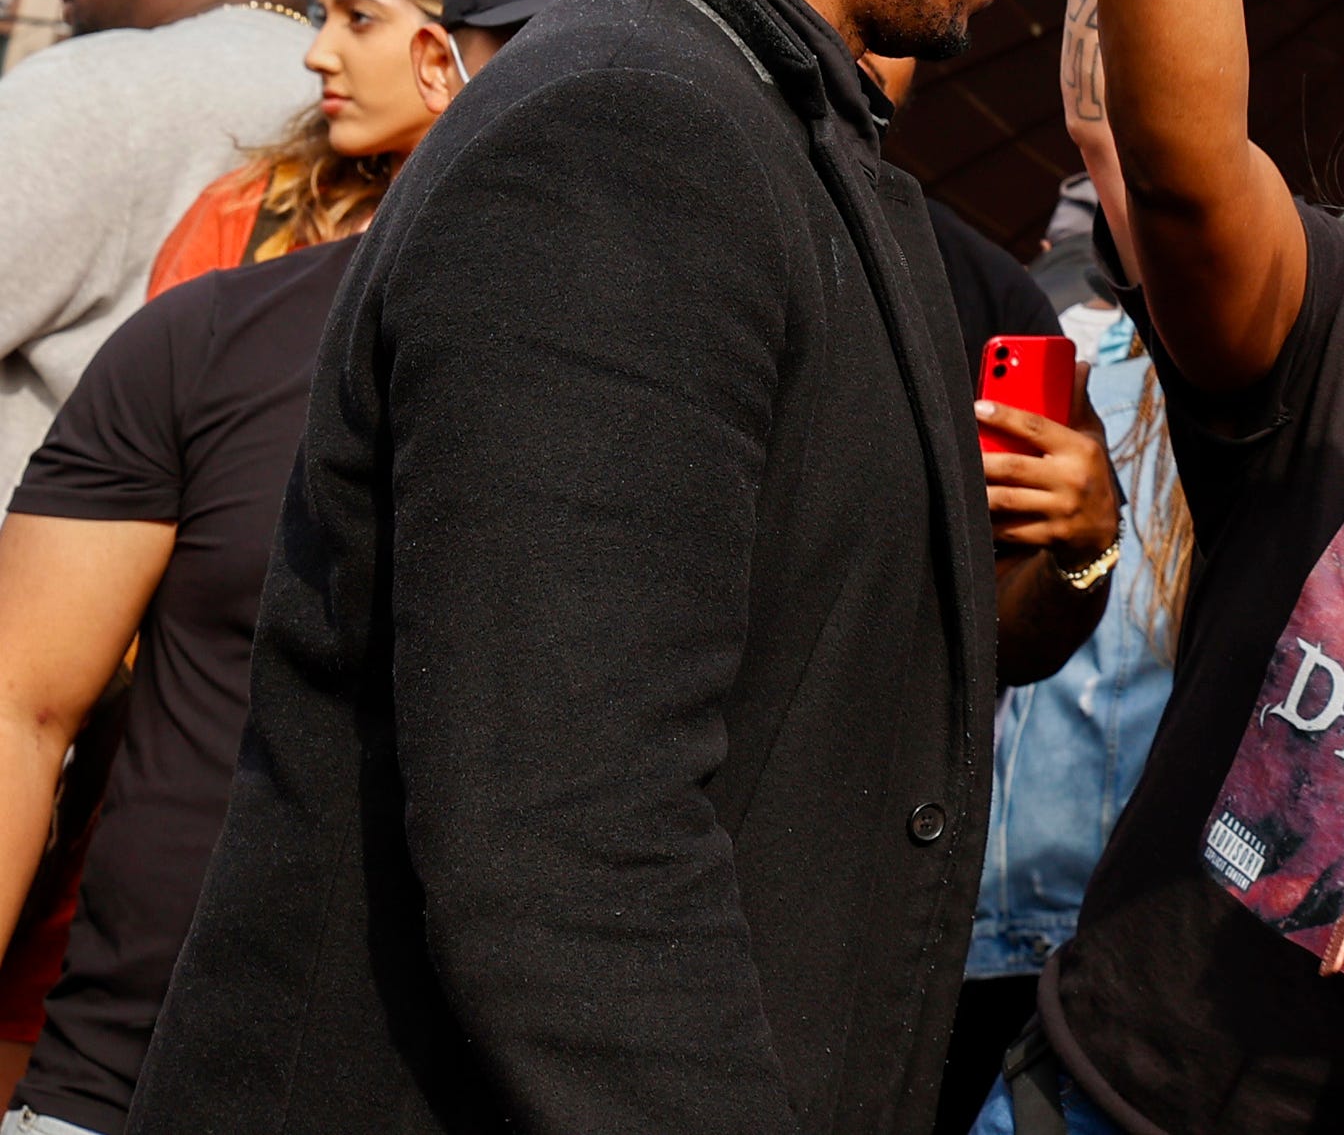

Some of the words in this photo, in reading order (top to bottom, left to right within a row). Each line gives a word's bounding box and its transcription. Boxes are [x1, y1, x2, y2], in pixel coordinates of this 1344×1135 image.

[1210, 825, 1263, 877] ADVISORY
[1221, 811, 1267, 856] PARENTAL
[1225, 865, 1251, 891] CONTENT
